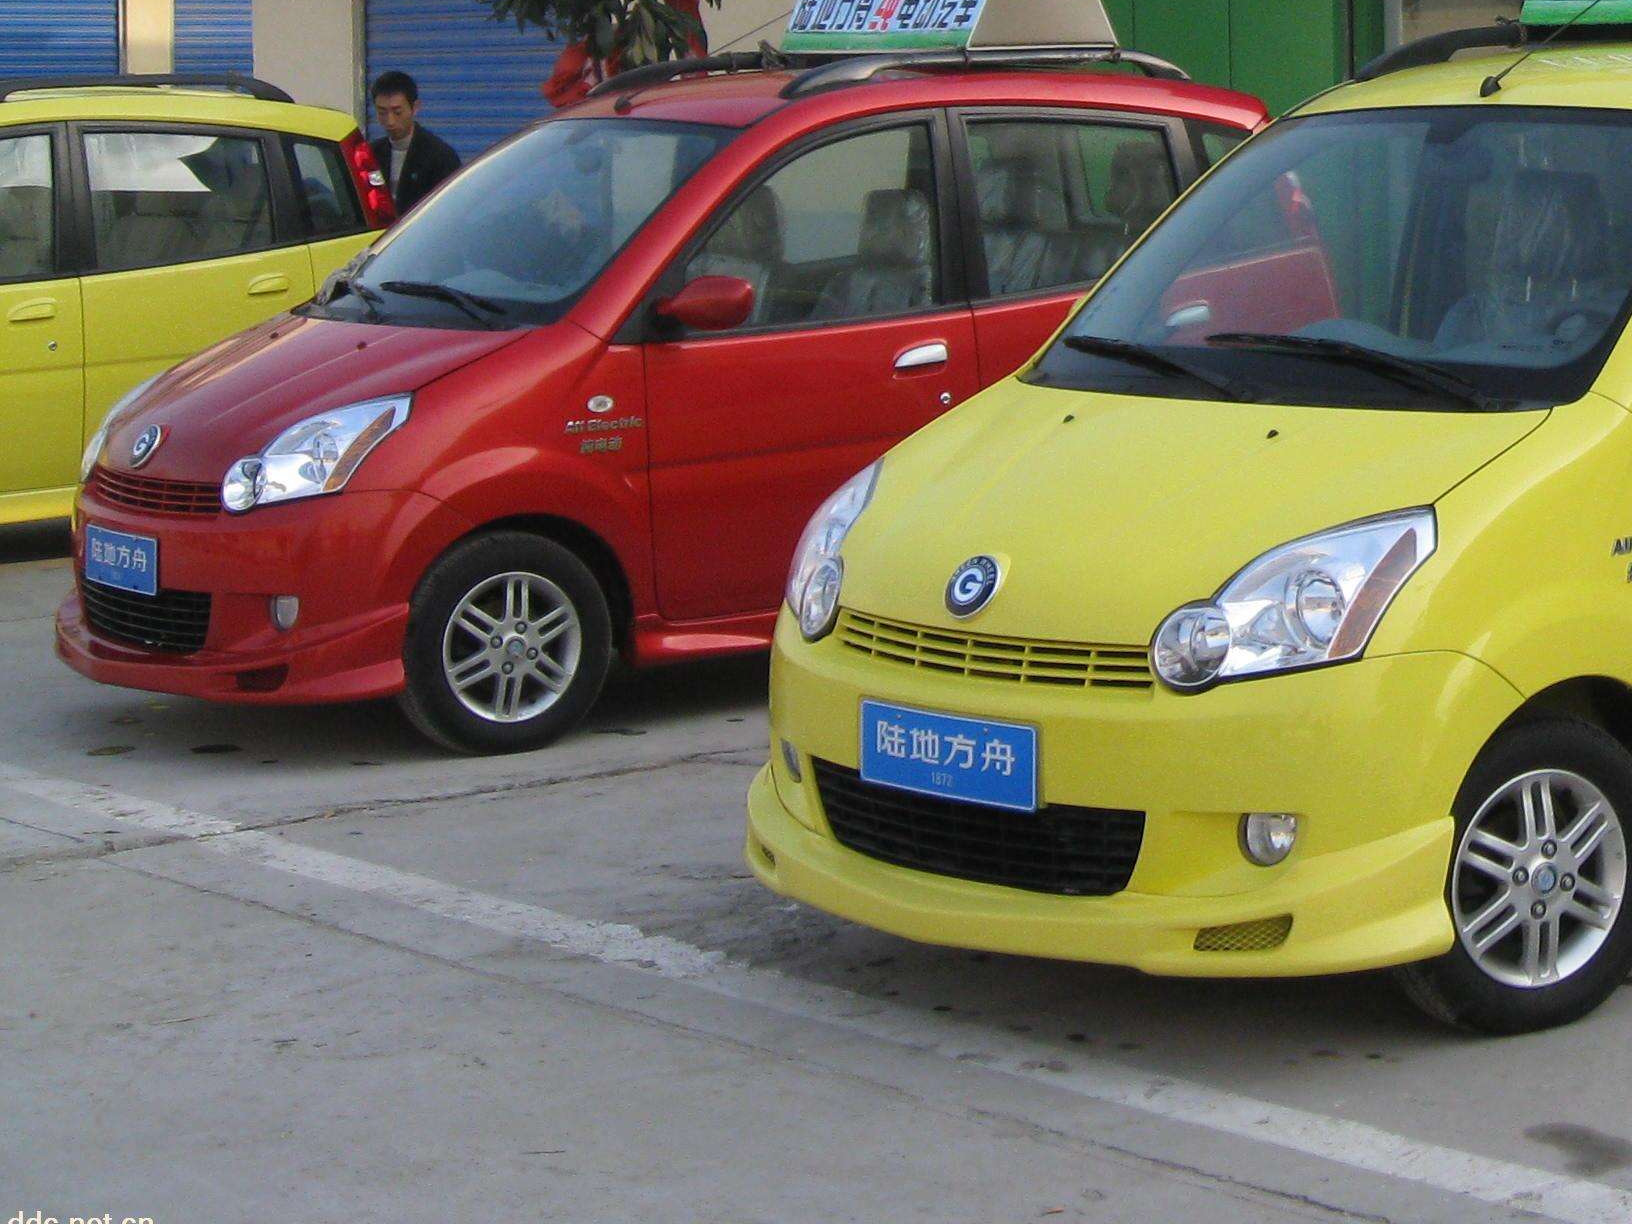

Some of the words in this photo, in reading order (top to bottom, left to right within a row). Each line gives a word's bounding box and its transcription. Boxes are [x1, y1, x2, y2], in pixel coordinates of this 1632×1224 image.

[91, 537, 147, 572] 陆地方舟
[1611, 537, 1632, 556] All
[876, 720, 1016, 776] 陆地方舟
